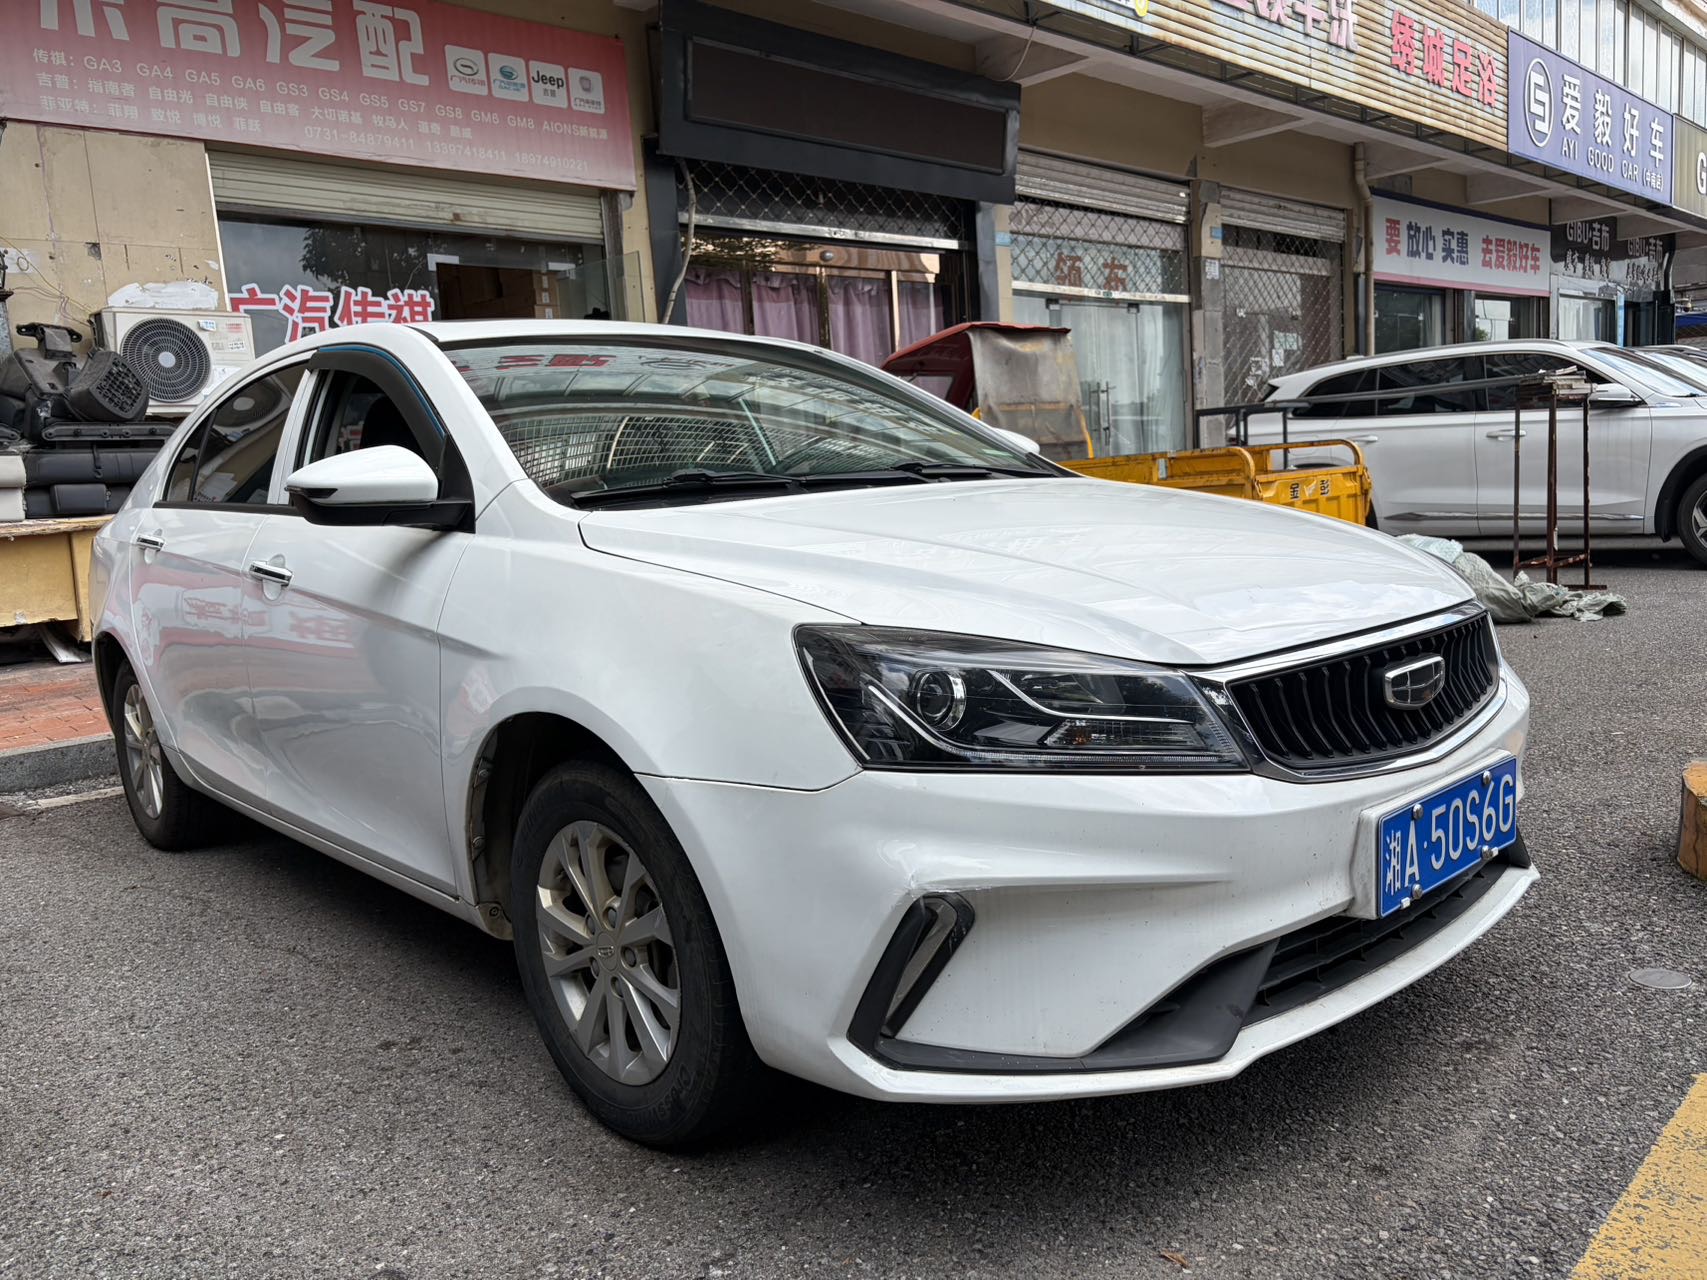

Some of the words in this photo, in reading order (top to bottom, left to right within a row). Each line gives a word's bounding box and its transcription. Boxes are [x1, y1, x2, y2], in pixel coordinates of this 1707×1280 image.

[84, 56, 122, 73] GA3
[137, 63, 173, 80] GA4
[185, 70, 221, 86] GA5
[232, 75, 266, 92] GA6
[276, 81, 309, 98] GS3
[319, 88, 350, 103] GS4
[359, 94, 389, 109] GS5
[398, 99, 426, 114] GS7
[435, 105, 463, 120] GS8
[507, 116, 535, 130] GM8
[88, 80, 136, 98] 指南者
[148, 88, 193, 105] 自由光
[532, 70, 565, 90] Jeep
[1562, 73, 1664, 168] 爱毅好车
[1562, 136, 1579, 161] AYI
[1587, 149, 1614, 174] GOOD
[1622, 159, 1640, 183] CAR
[1385, 217, 1401, 257] 要
[1406, 221, 1436, 262] 放心
[1442, 226, 1469, 266] 实惠
[1481, 235, 1541, 276] 去爱毅好车
